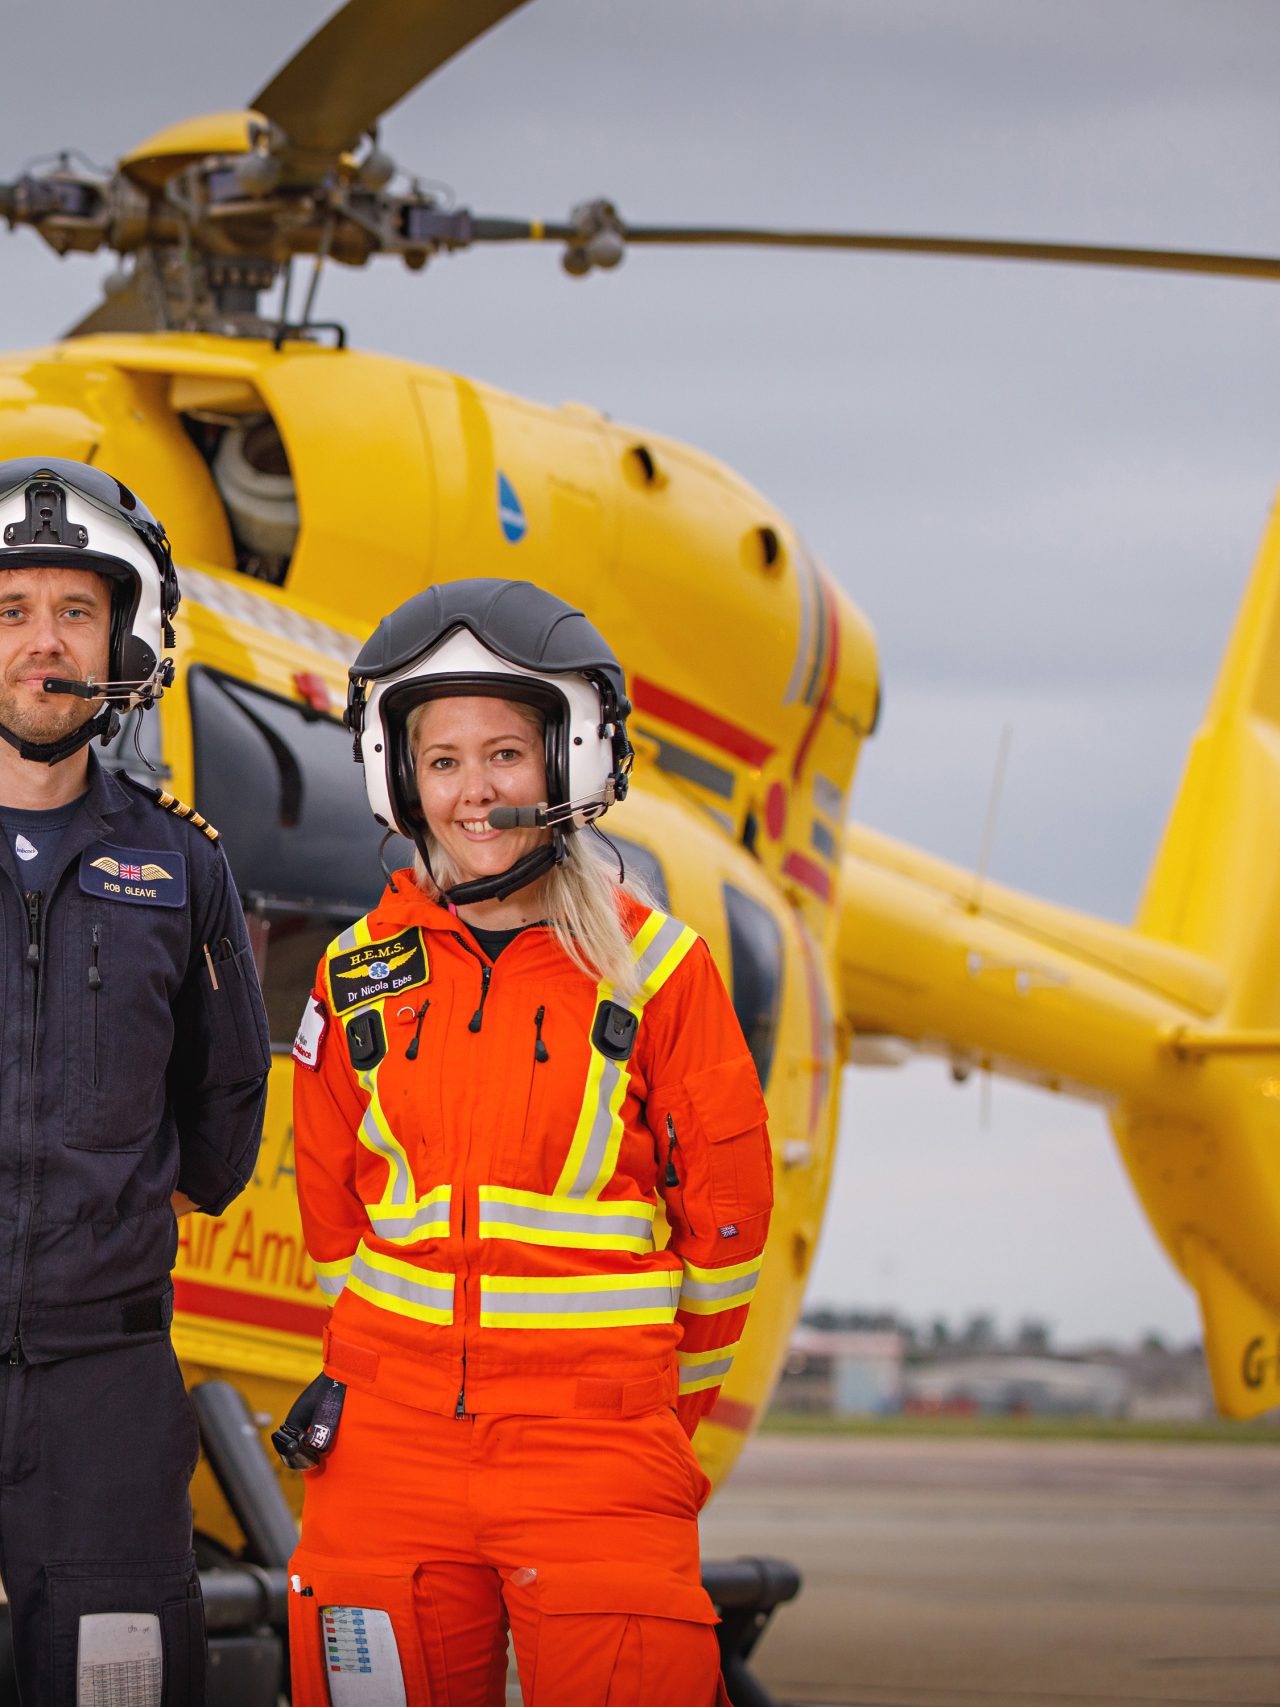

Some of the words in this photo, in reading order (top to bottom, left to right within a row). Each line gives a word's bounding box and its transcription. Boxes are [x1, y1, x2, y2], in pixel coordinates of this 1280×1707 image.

[104, 882, 120, 893] ROB
[125, 886, 157, 898] GLEAVE
[350, 943, 404, 966] H.E.M.S.
[348, 991, 358, 1002] Dr
[361, 981, 389, 997] Nicola
[393, 974, 412, 989] Ebbs
